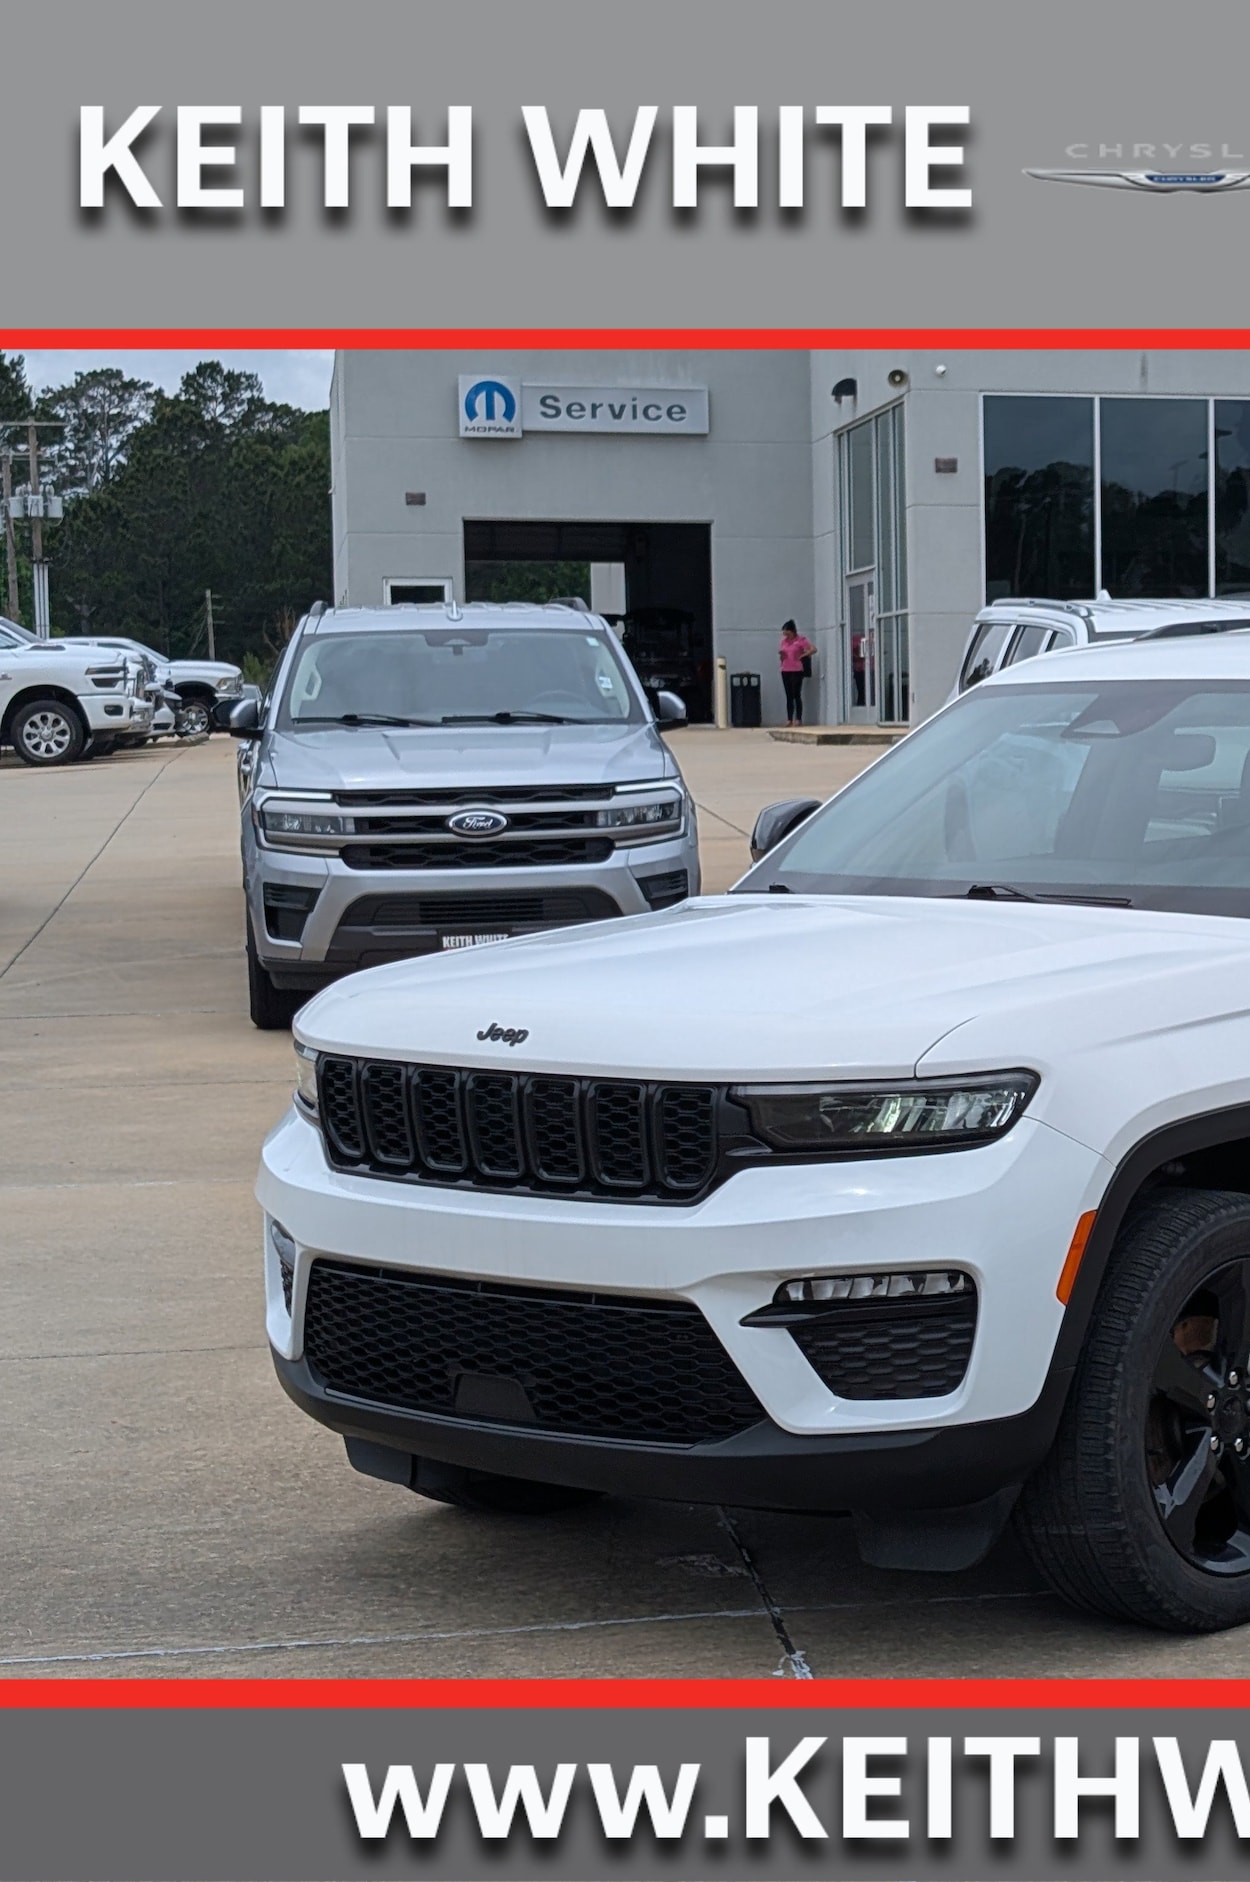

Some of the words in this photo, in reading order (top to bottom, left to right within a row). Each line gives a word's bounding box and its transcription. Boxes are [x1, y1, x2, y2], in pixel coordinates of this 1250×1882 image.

[539, 394, 688, 422] Service
[464, 425, 515, 433] MOPAR
[463, 816, 493, 829] Ford
[442, 935, 473, 949] KEITH
[477, 1022, 529, 1047] Jeep
